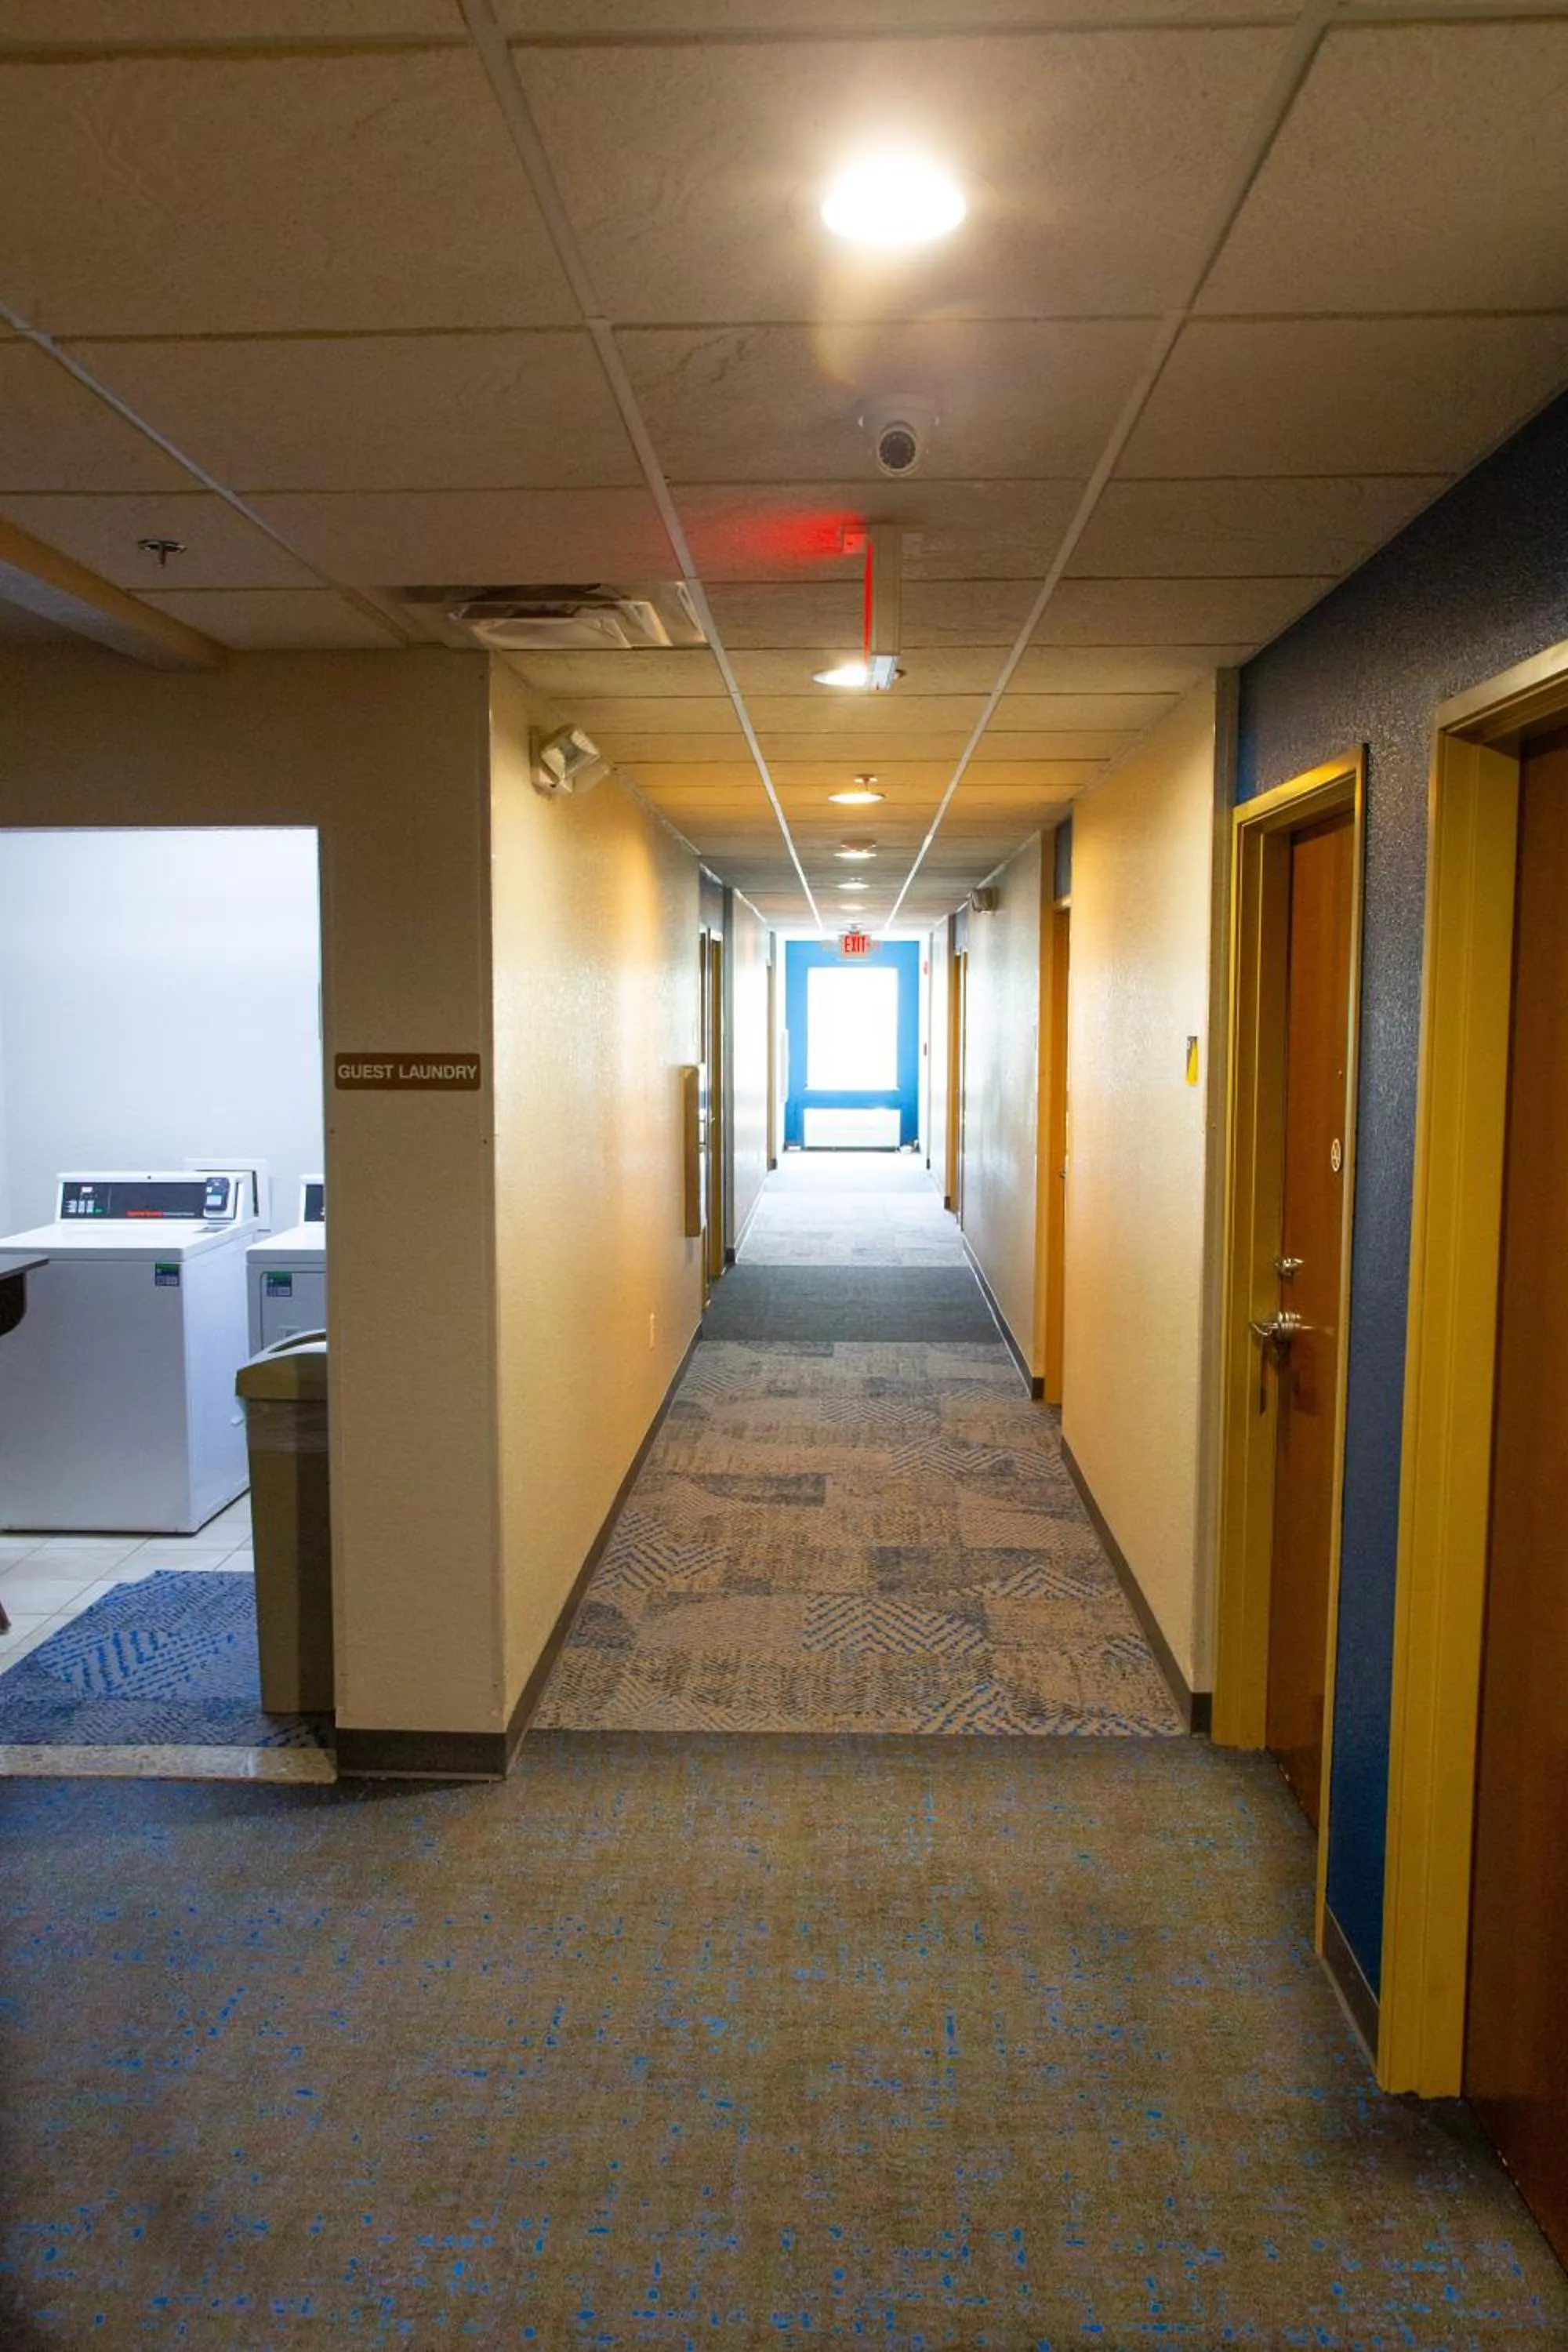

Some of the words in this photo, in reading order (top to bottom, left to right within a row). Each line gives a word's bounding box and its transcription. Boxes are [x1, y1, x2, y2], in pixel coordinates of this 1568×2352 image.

[844, 935, 866, 953] EXIT
[338, 1064, 394, 1080] GUEST
[399, 1064, 477, 1080] LAUNDRY
